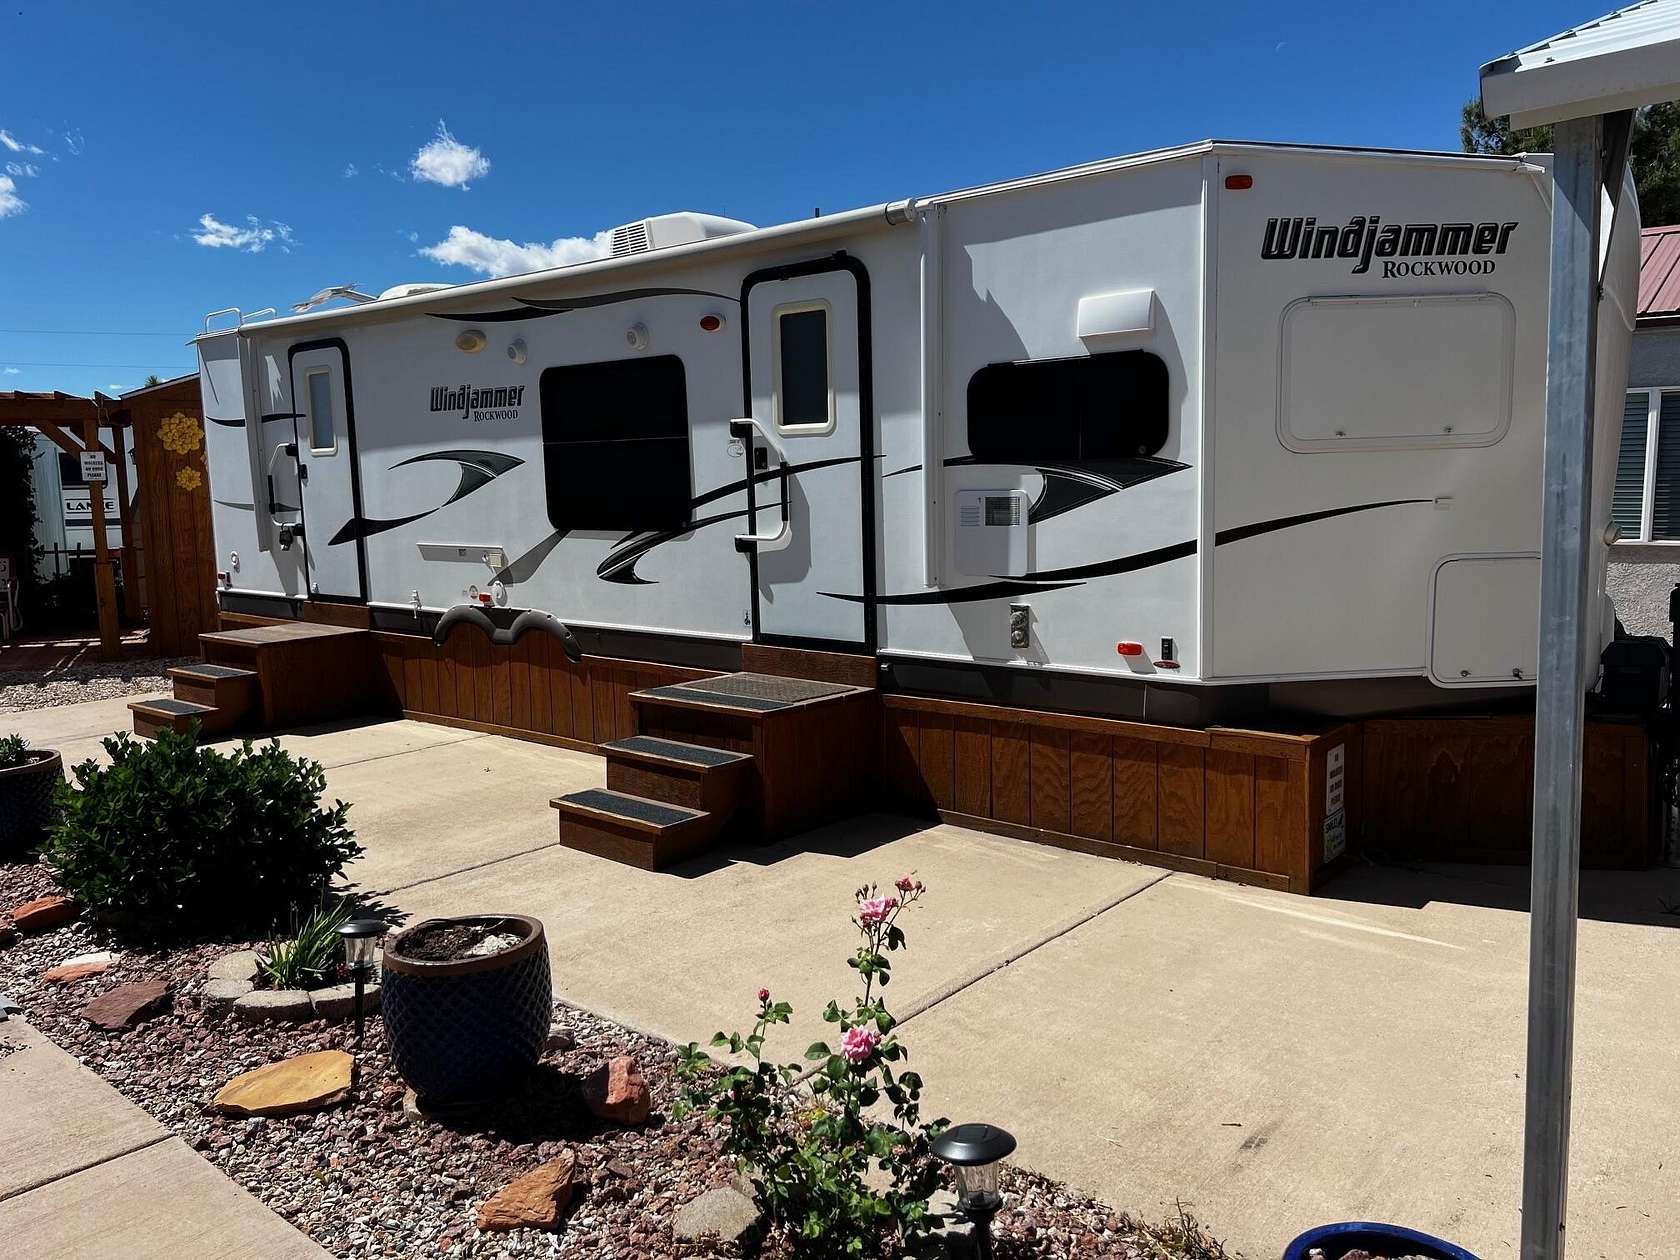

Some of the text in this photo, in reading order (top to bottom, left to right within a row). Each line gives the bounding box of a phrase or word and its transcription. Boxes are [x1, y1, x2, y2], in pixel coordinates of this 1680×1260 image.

[1261, 215, 1519, 274] Windjammer
[1382, 259, 1496, 279] ROCKWOOD
[430, 384, 525, 419] Windjammer
[474, 410, 518, 422] ROCKWOOD
[66, 501, 114, 511] LANE
